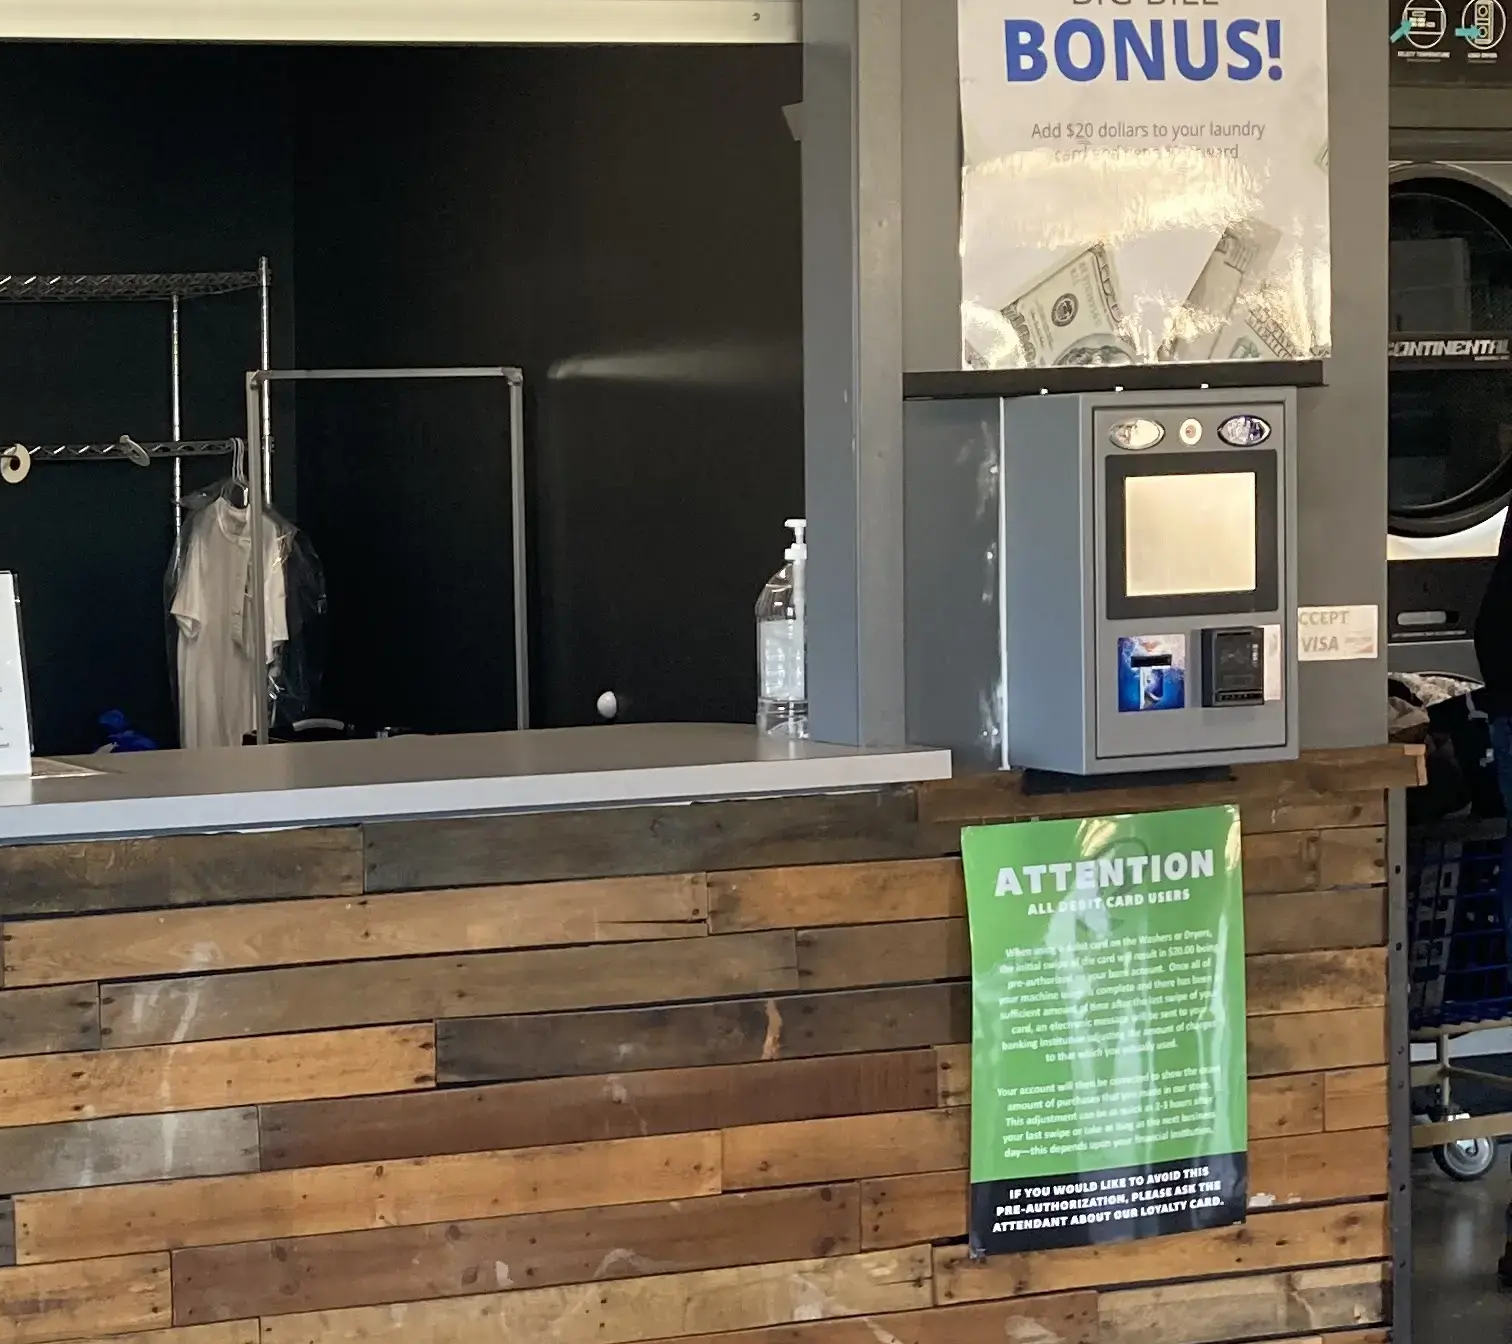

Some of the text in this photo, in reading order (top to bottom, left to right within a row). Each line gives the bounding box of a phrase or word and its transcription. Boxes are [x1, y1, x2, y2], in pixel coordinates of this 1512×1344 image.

[1004, 18, 1283, 83] BONUS!
[1031, 121, 1266, 141] Add $20 dollars to your laundry
[1301, 636, 1339, 652] VISA
[994, 849, 1214, 897] ATTENTION
[1027, 902, 1055, 915] ALL
[1106, 893, 1144, 908] CARD
[1148, 888, 1190, 904] USERS
[996, 1180, 1221, 1216] PRE-AUTHORIZATION, PLEASE ASK THE
[1009, 1166, 1209, 1200] IF YOU WOULD LIKE TO AVOID THIS
[992, 1196, 1224, 1233] ATTENDANT ABOUT OUR LOYALTY CARD.
